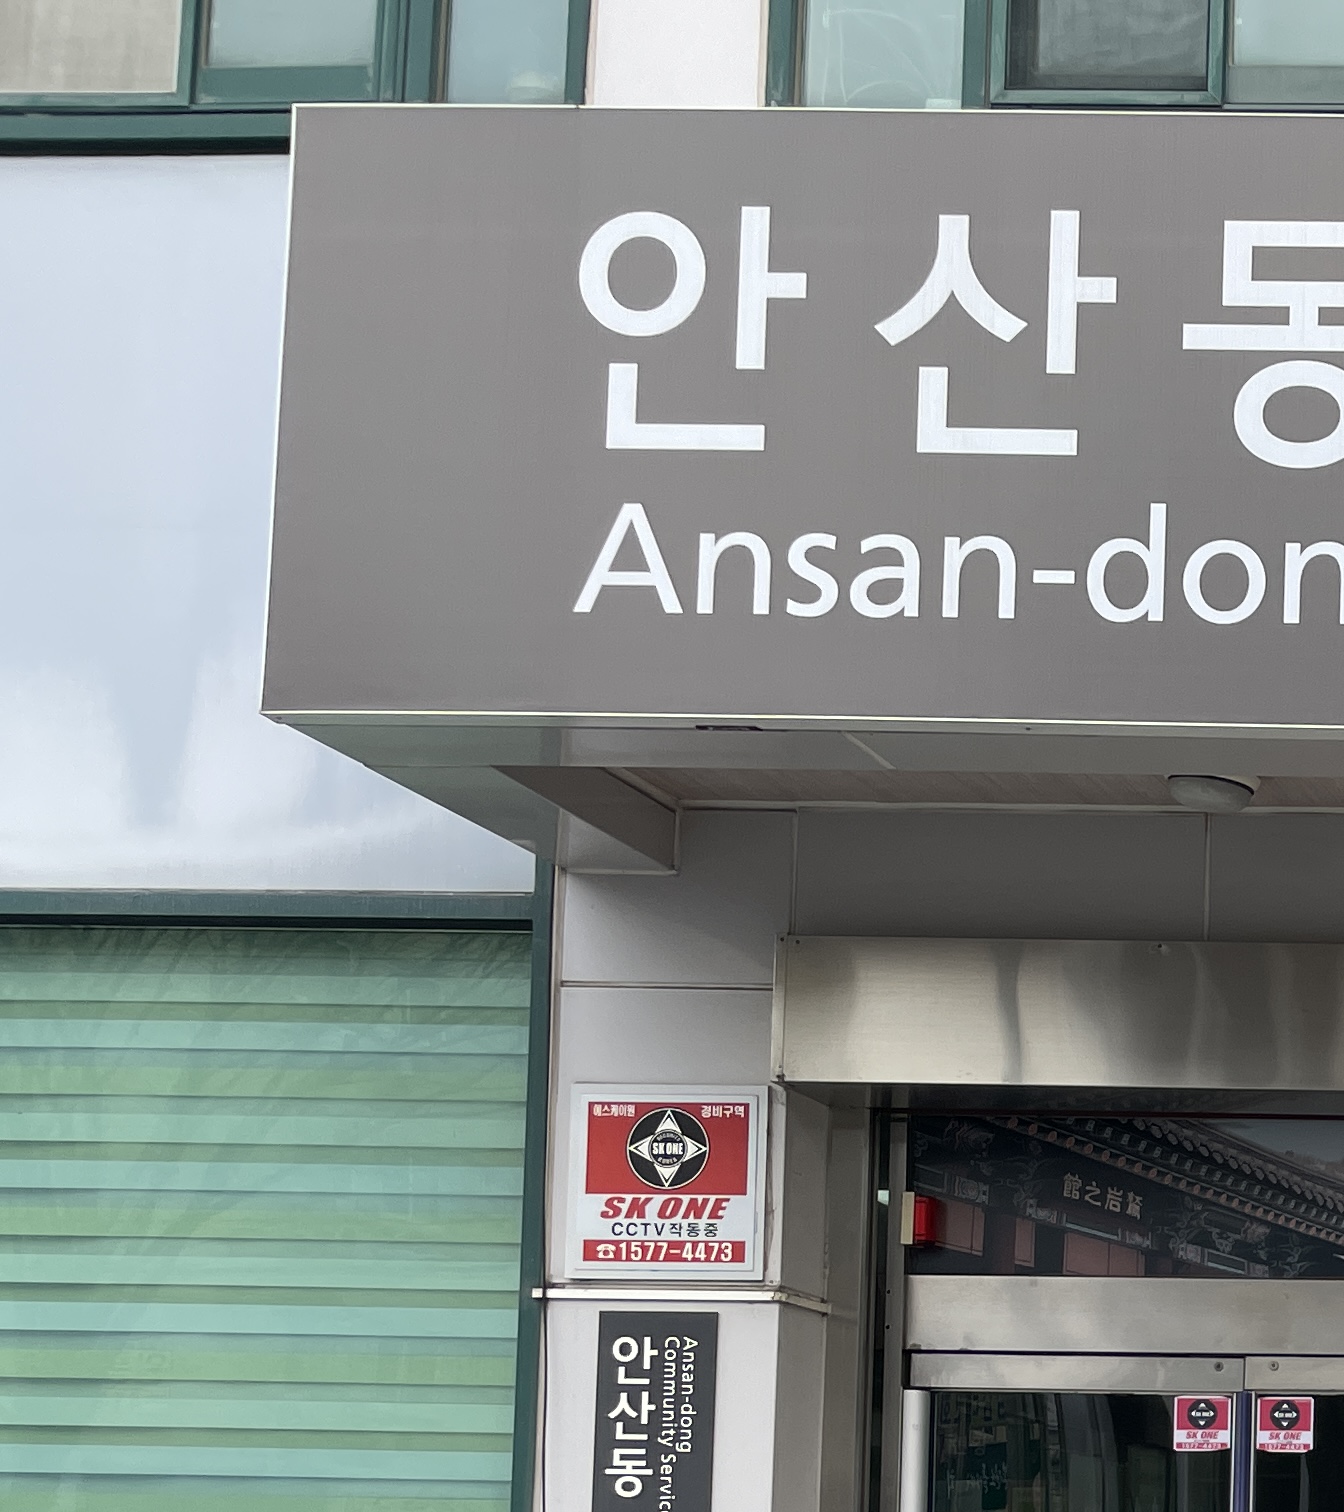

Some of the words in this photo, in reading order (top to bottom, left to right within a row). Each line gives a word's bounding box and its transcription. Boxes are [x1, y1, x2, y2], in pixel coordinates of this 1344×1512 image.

[701, 1105, 745, 1118] 경비구역
[652, 1142, 665, 1155] SK
[666, 1142, 684, 1155] ONE
[600, 1196, 654, 1219] SK
[656, 1197, 730, 1220] ONE
[619, 1241, 733, 1262] 1577-4473
[657, 1335, 681, 1448] Community
[675, 1335, 699, 1454] Ansan-dong
[604, 1335, 659, 1498] 안산동
